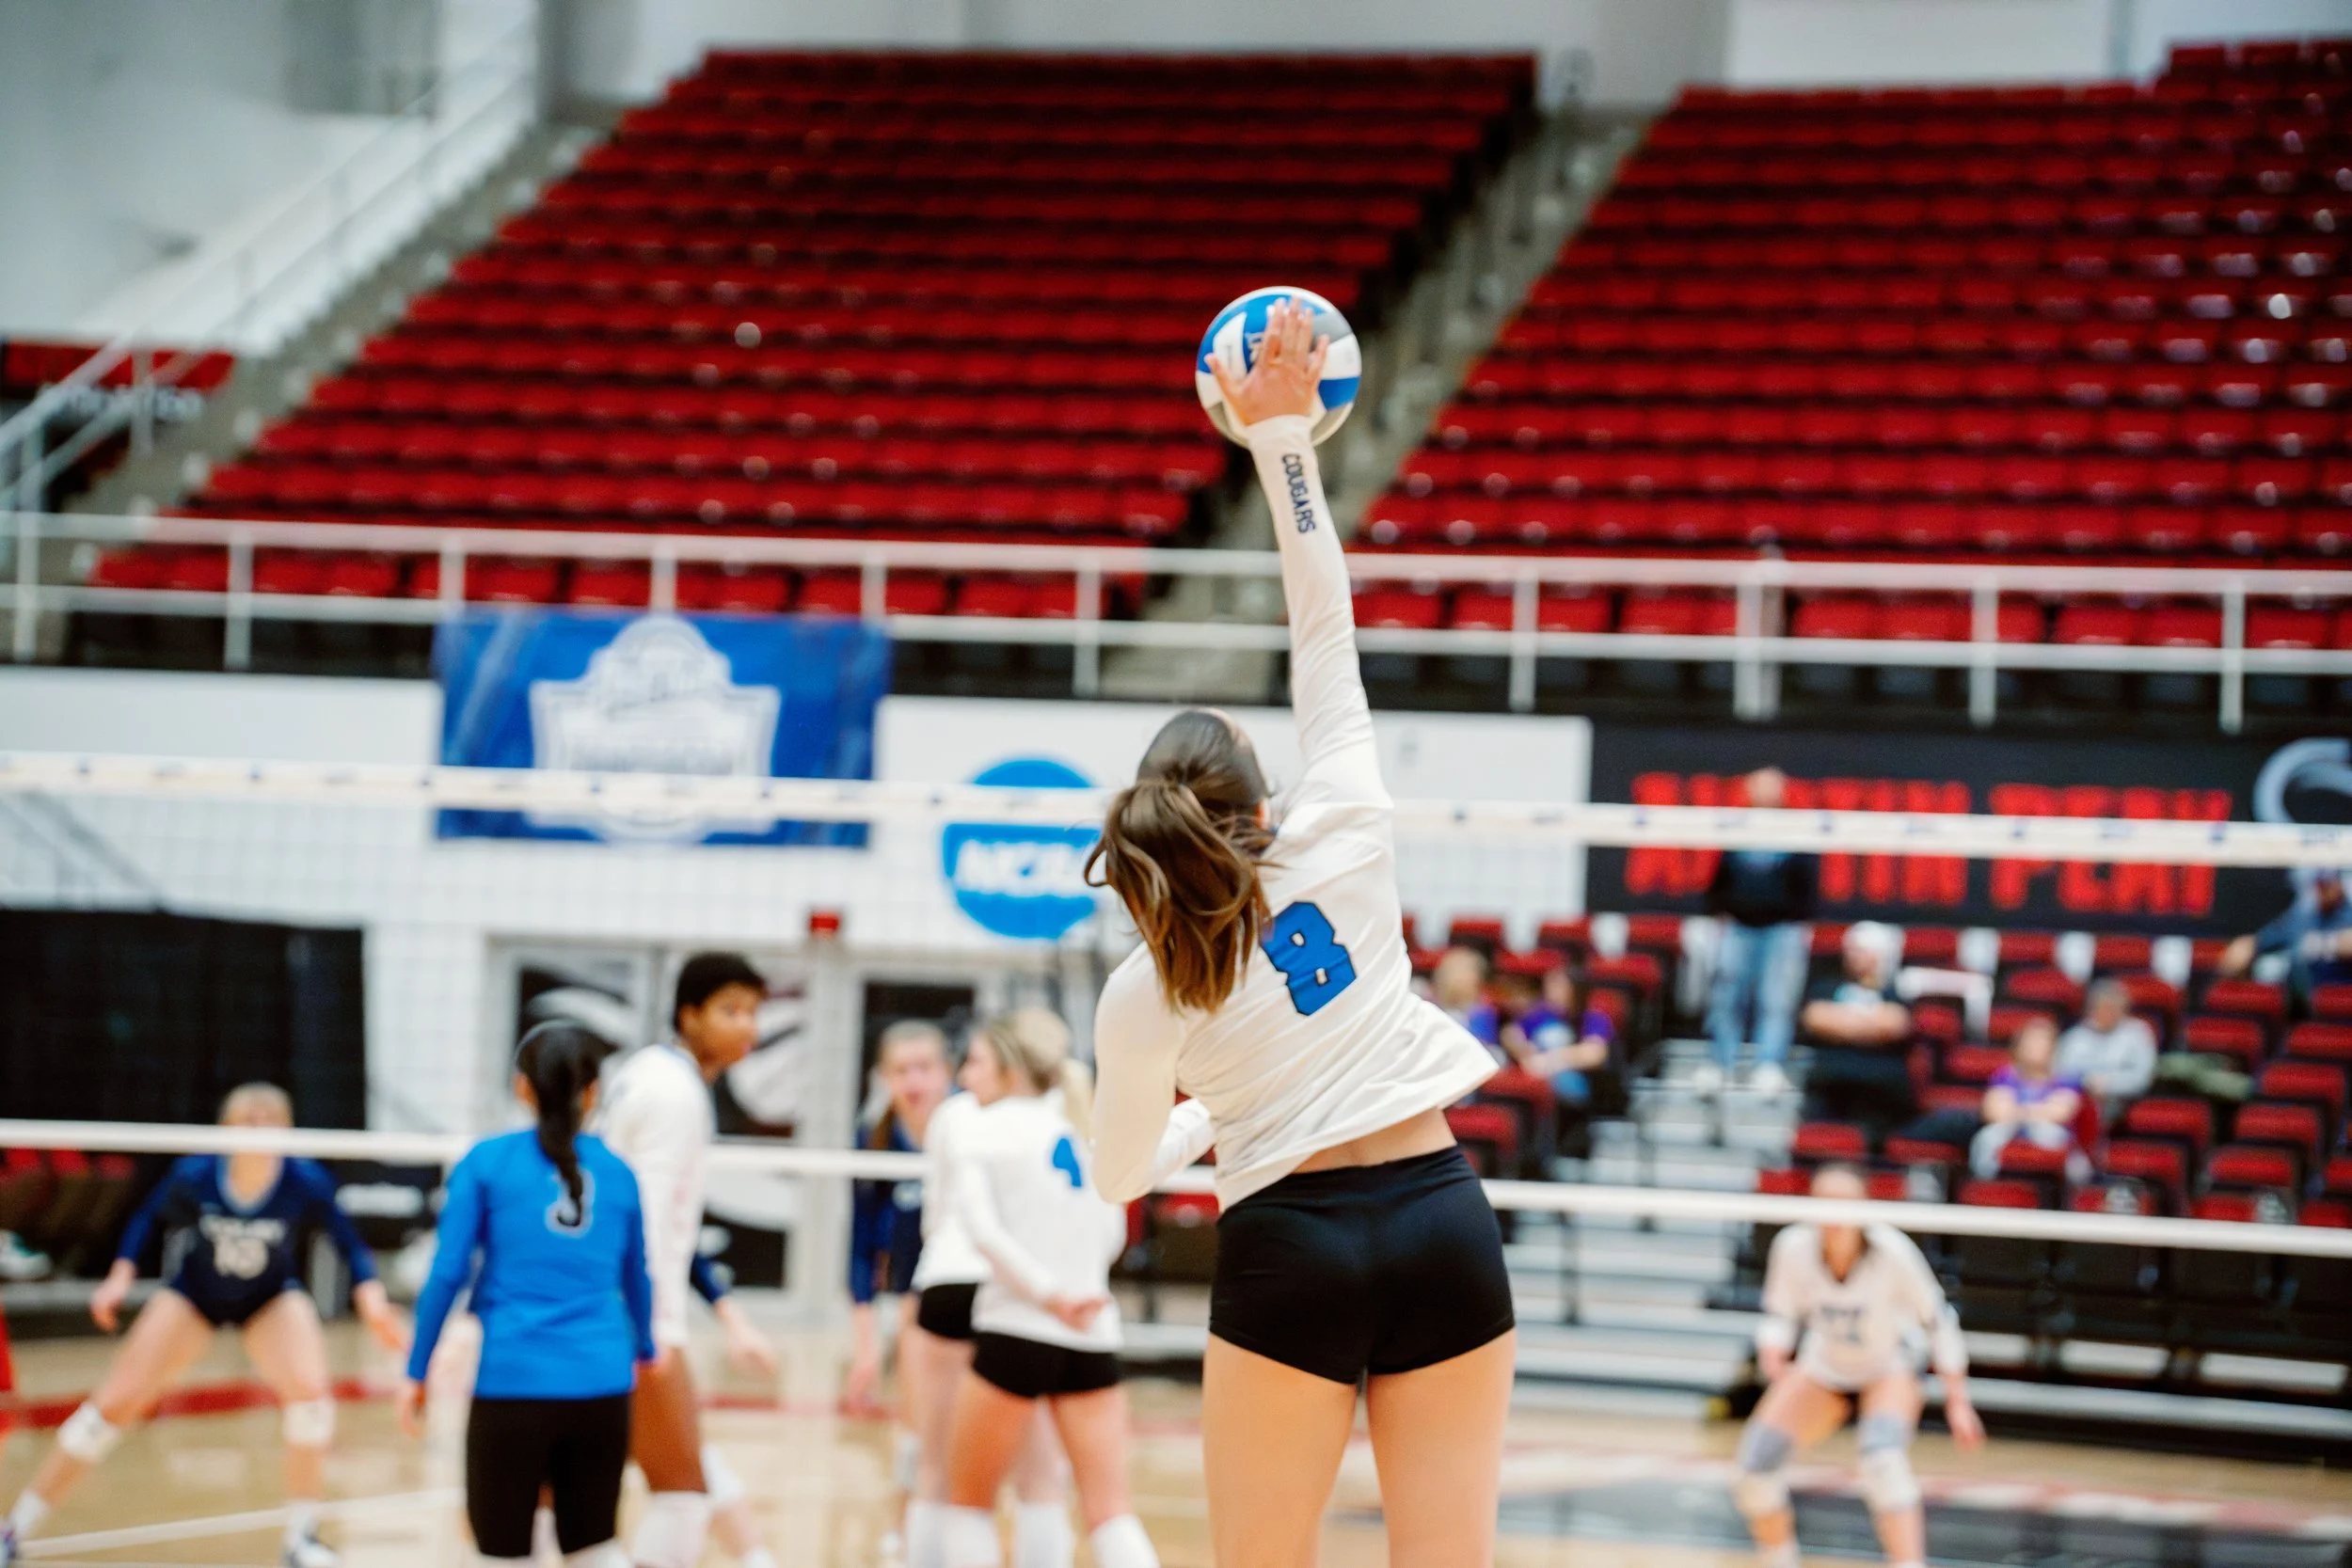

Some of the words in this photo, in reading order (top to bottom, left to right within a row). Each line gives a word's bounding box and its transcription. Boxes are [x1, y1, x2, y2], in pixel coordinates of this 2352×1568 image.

[1282, 454, 1315, 533] COUGARS
[1626, 771, 1970, 907] AUTIN
[1261, 901, 1358, 1017] 8
[1053, 1137, 1082, 1187] 4
